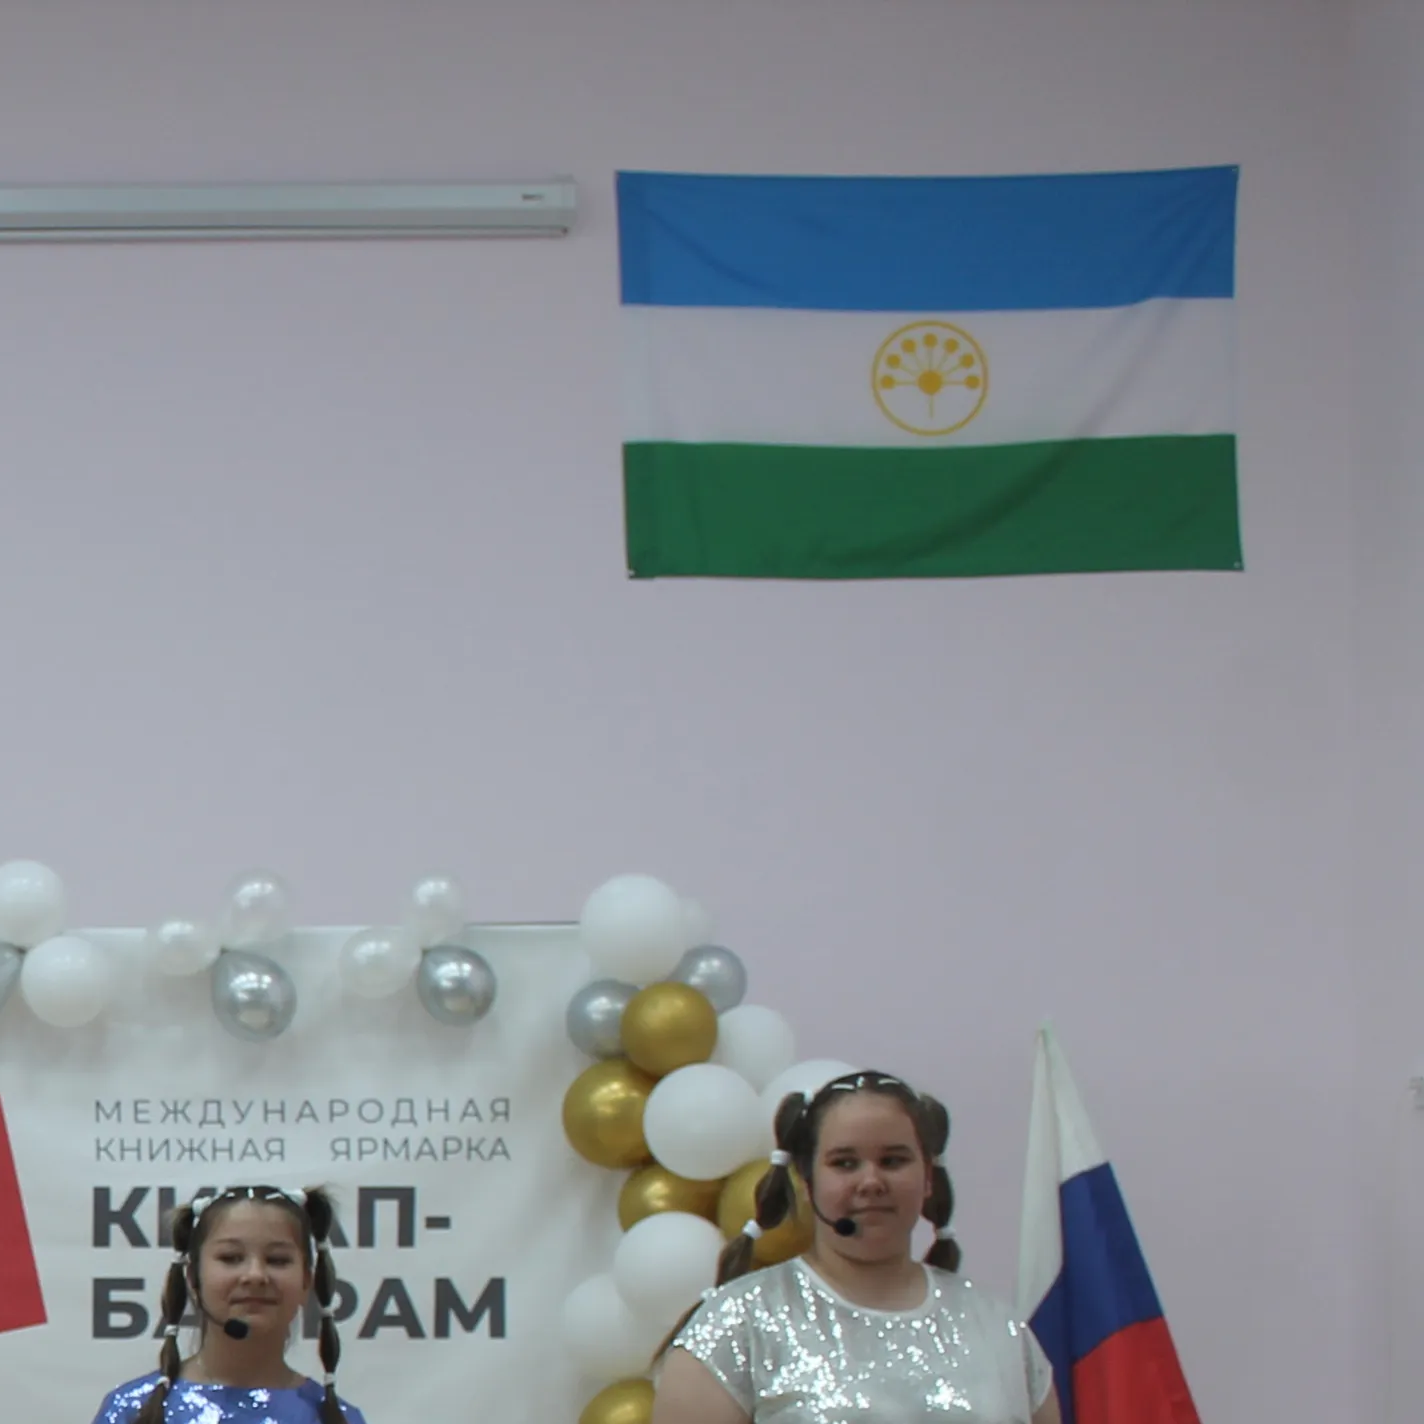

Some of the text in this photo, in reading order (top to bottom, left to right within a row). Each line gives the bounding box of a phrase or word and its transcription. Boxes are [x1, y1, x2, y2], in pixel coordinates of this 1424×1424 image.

[94, 1098, 512, 1129] МЕЖДУНАРОДНАЯ
[94, 1136, 512, 1162] КНИЖНАЯ ЯРМАРКА
